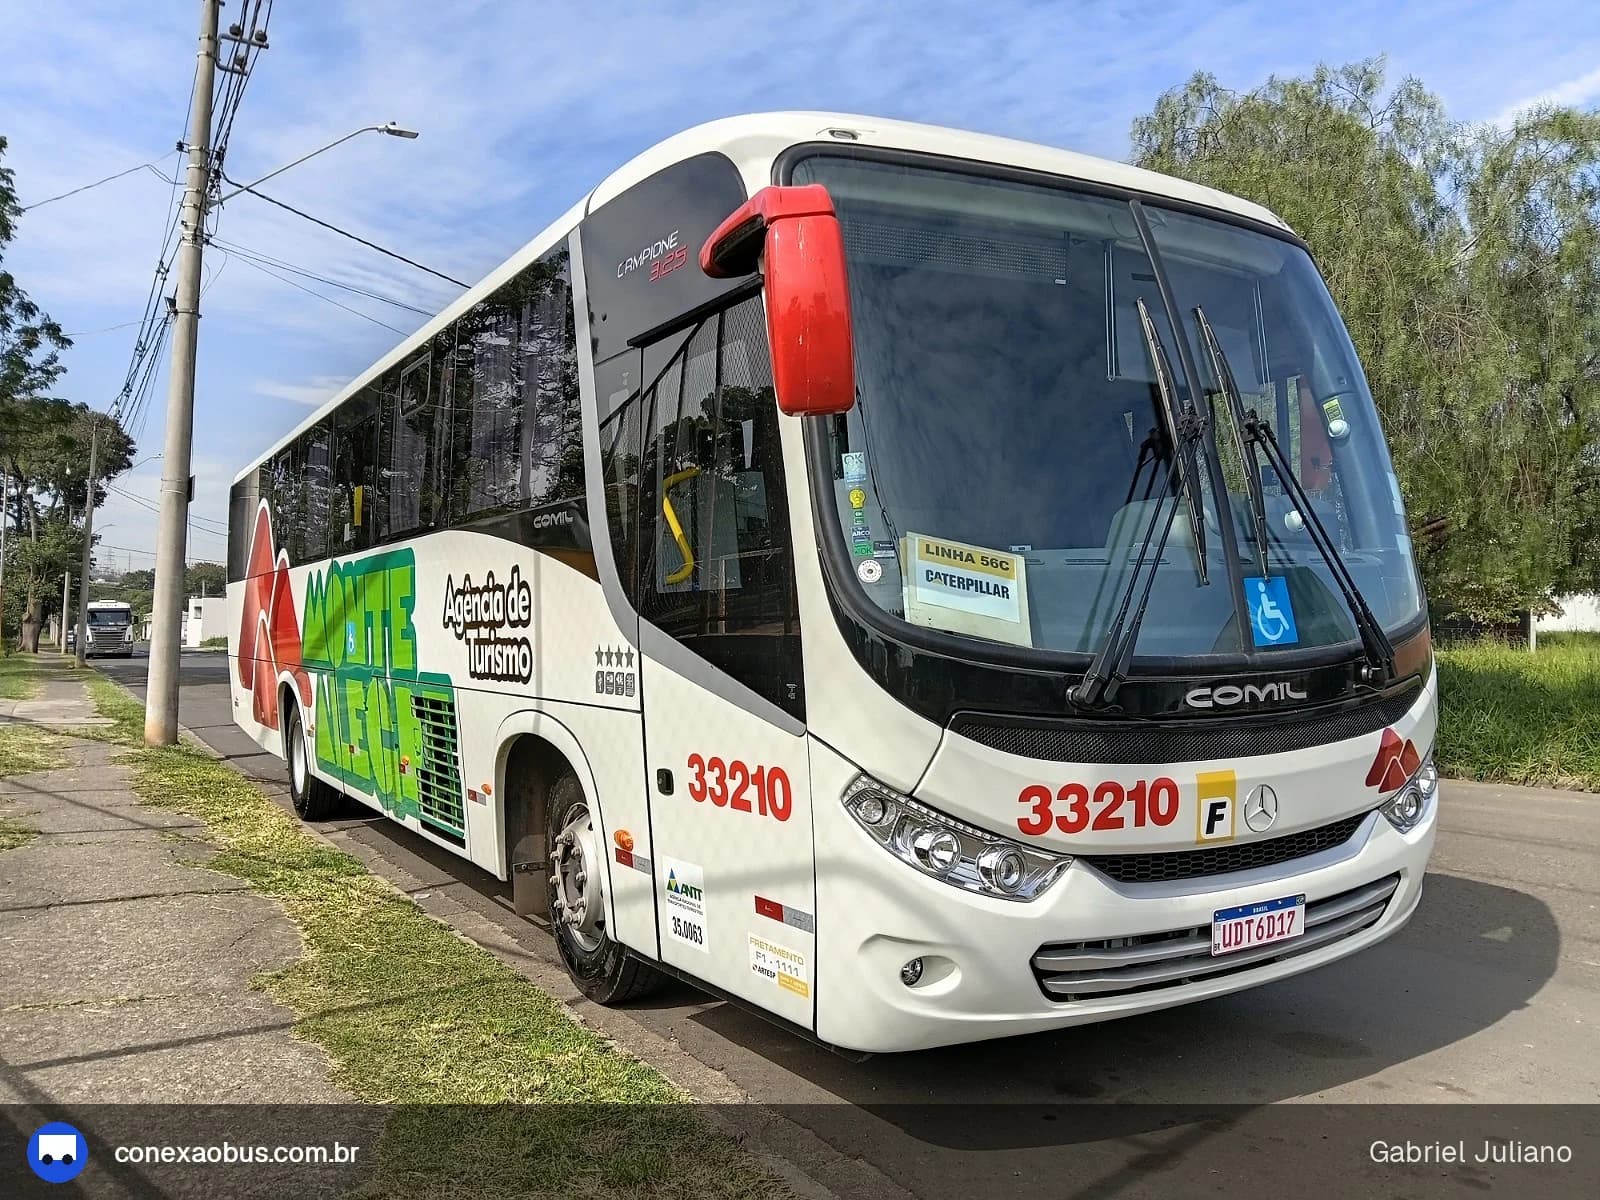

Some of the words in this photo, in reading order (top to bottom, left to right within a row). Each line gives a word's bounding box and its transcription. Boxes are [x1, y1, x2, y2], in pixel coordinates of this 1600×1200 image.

[617, 230, 679, 278] CAMPIONE
[533, 511, 574, 529] COMIL
[925, 543, 976, 564] LINHA
[980, 555, 1010, 571] 56C
[925, 569, 1010, 600] CATERPILLAR
[302, 558, 415, 673] MONTE
[443, 570, 505, 640] Agência
[506, 564, 531, 628] de
[465, 627, 533, 684] Turismo
[1185, 682, 1307, 708] COMIL
[687, 753, 792, 822] 33210
[1016, 777, 1179, 836] 33210
[1205, 801, 1227, 835] F
[680, 883, 703, 901] ANTT
[672, 915, 703, 945] 35.0063
[1222, 910, 1296, 948] UDT6D17
[750, 936, 804, 966] FRETAMENTO
[756, 951, 766, 963] F1
[776, 959, 799, 977] 1111
[757, 966, 776, 979] ARTESP
